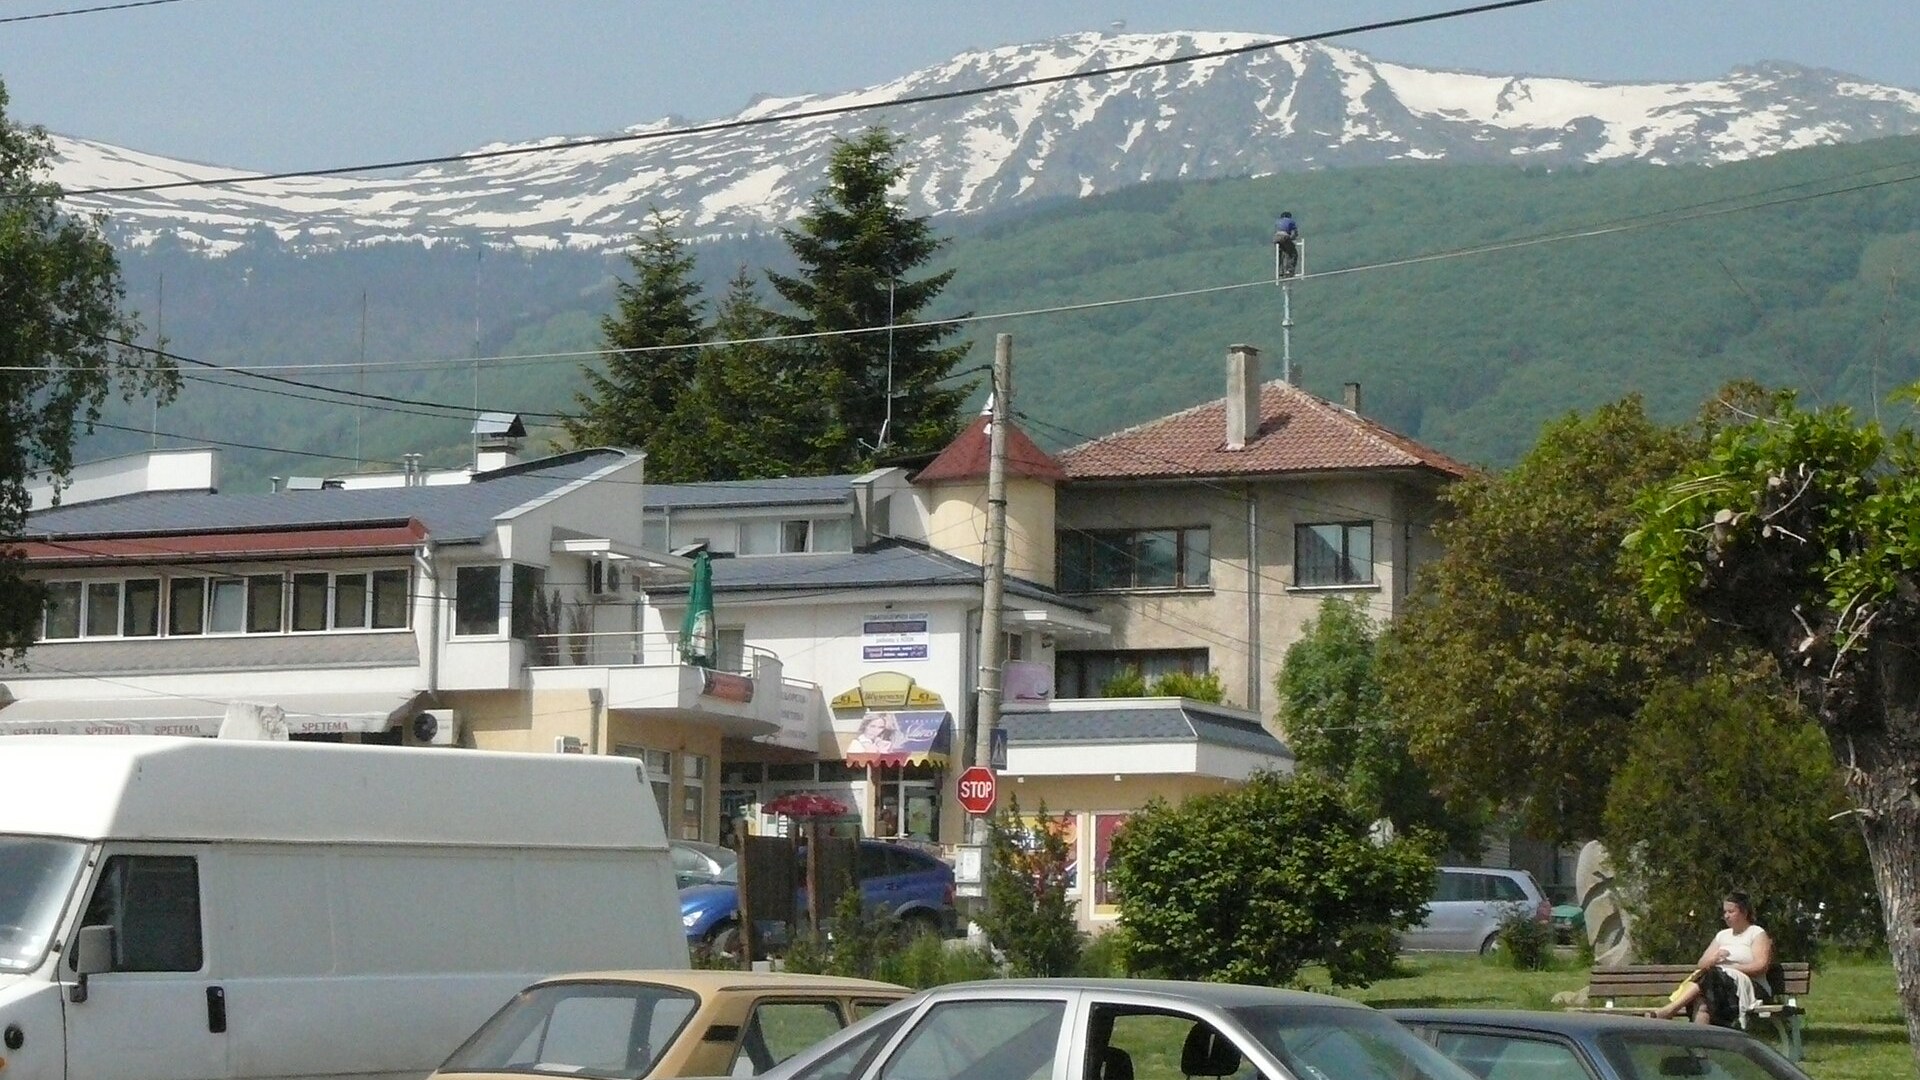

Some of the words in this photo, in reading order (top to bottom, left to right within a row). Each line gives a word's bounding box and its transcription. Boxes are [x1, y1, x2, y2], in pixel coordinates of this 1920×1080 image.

[85, 725, 131, 735] SPETEMA
[154, 724, 200, 735] SPETEMA
[301, 721, 349, 732] SPETEMA
[960, 781, 992, 798] STOP
